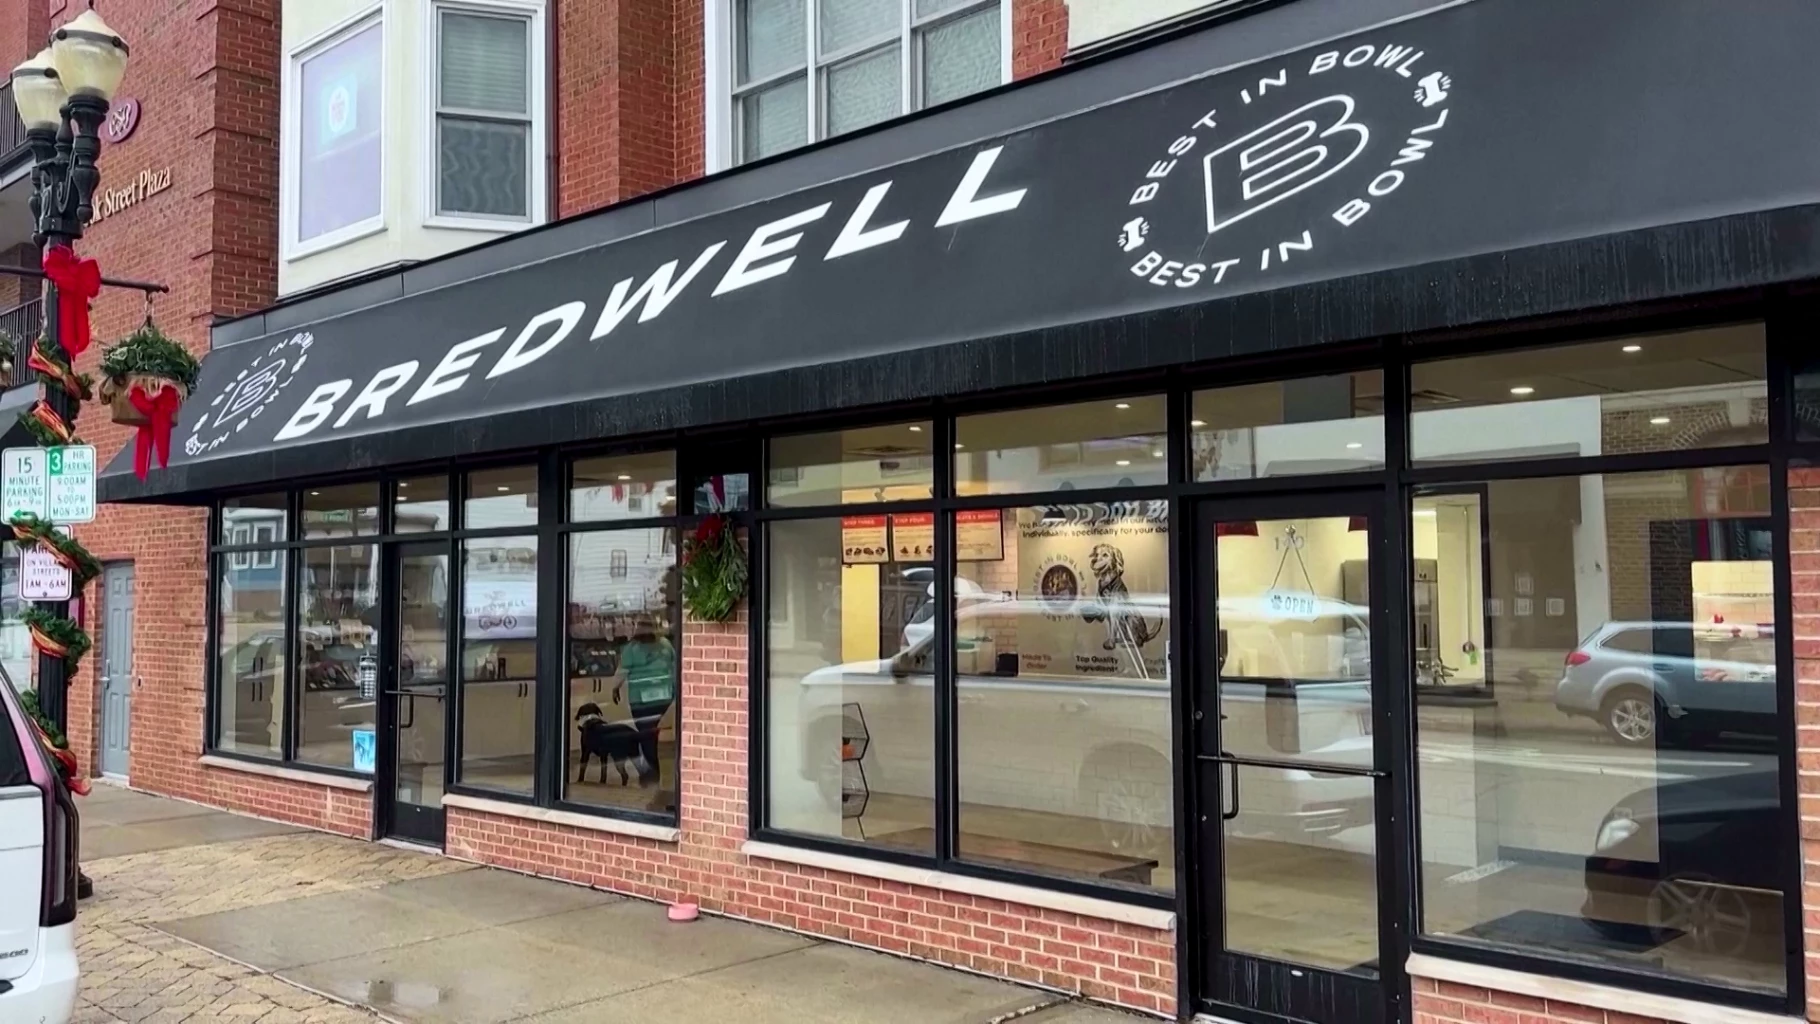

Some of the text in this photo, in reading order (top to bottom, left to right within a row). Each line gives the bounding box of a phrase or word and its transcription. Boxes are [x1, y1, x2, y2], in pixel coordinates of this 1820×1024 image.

[1129, 43, 1425, 206] BEST IN BOWL
[104, 178, 137, 217] Street
[139, 165, 171, 201] Plaza
[1130, 108, 1449, 289] BEST IN BOWL
[273, 145, 1028, 443] BREDWELL
[72, 450, 85, 460] HR
[18, 456, 33, 474] 15
[51, 452, 62, 472] 3
[64, 462, 92, 471] PARKING
[9, 475, 41, 486] MINUTE
[6, 486, 44, 498] PARKING
[1120, 526, 1133, 535] for
[1134, 526, 1154, 536] your
[39, 558, 60, 567] VILLA
[32, 567, 61, 576] STREETS
[25, 579, 42, 590] 1AM
[49, 579, 67, 590] 6AM
[1284, 595, 1314, 614] OPEN
[1075, 655, 1119, 665] Top Quality
